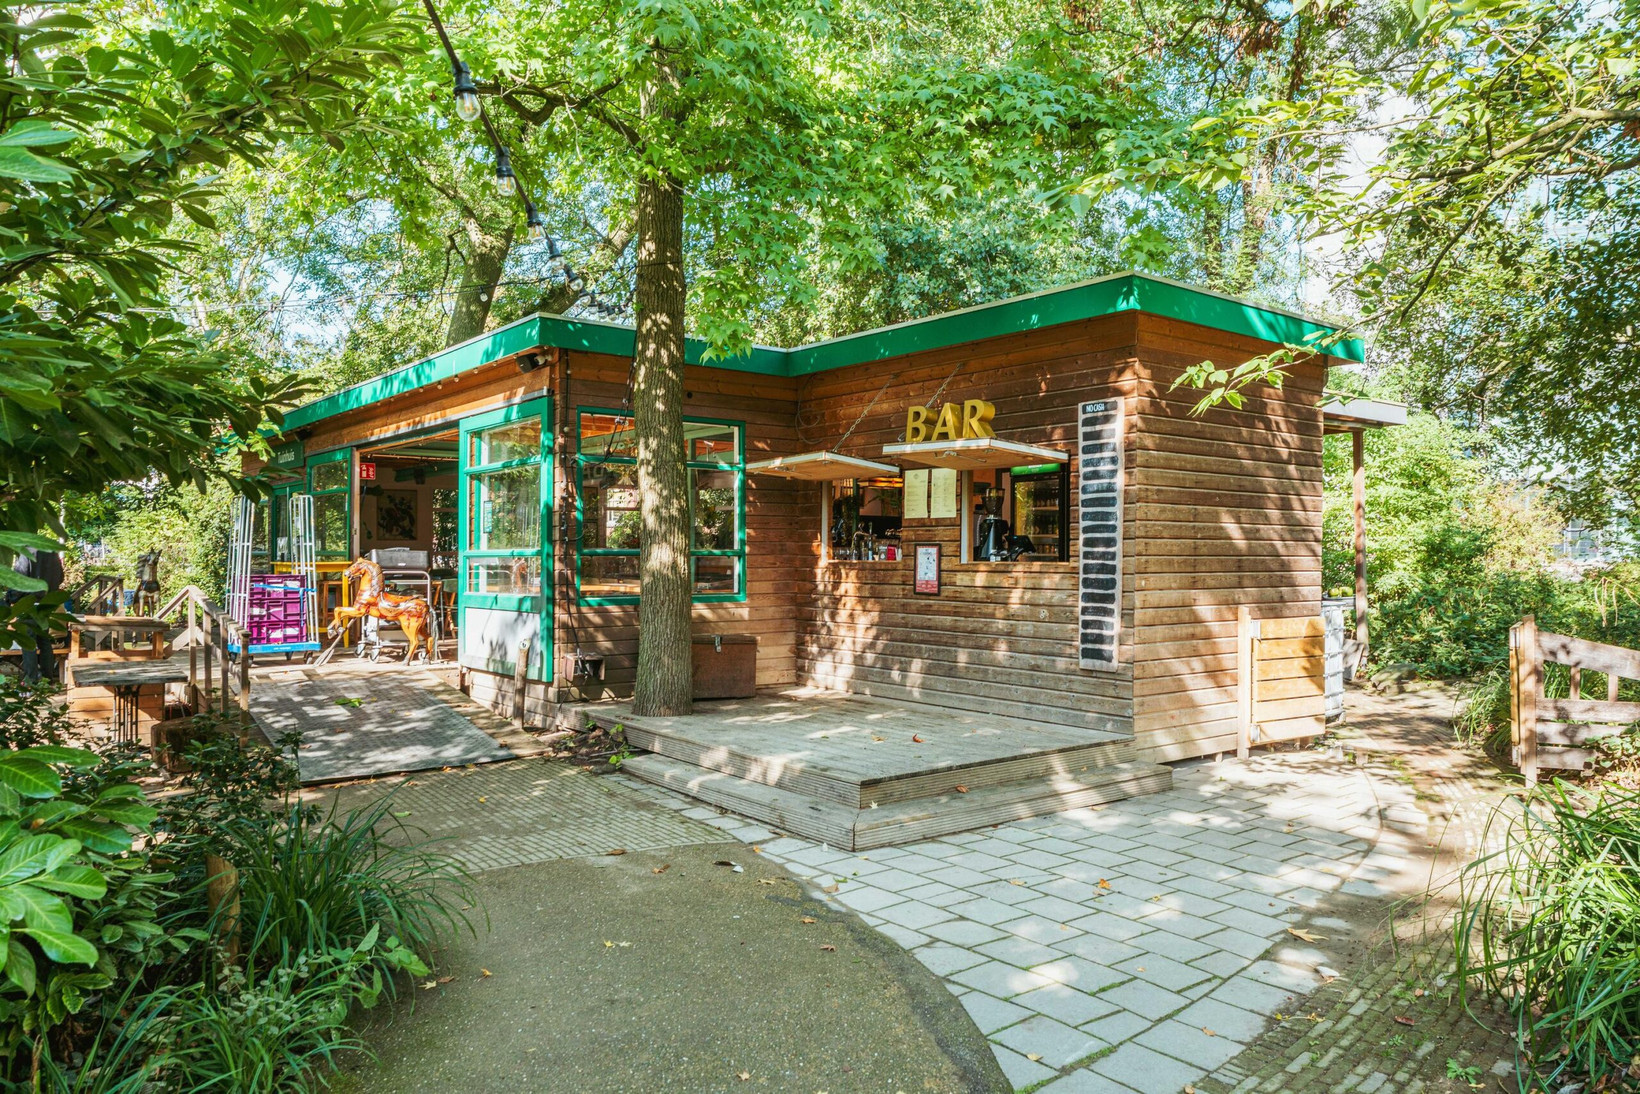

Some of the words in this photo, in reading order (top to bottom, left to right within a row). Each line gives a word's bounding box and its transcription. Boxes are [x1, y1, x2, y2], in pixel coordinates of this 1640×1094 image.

[906, 399, 996, 443] BAR
[1085, 404, 1093, 413] NO
[1093, 403, 1105, 412] CASH
